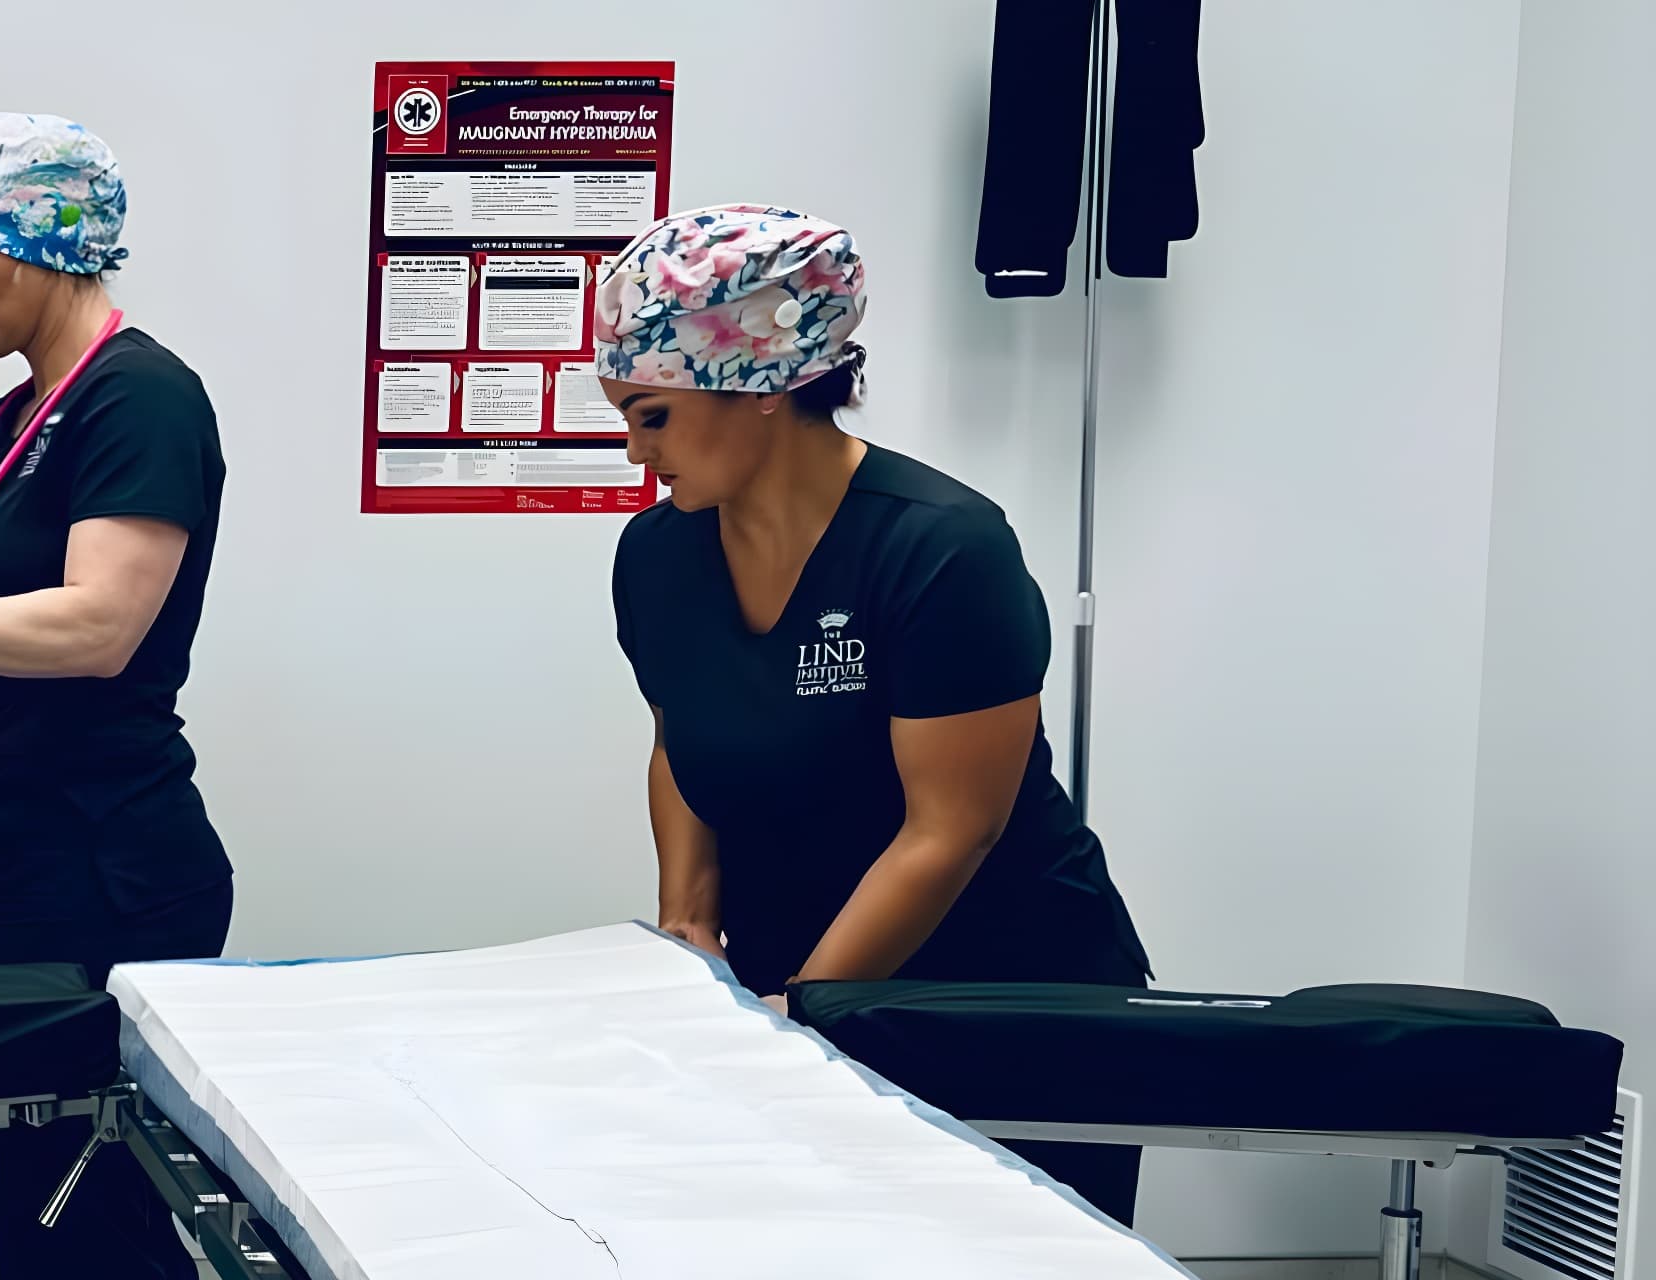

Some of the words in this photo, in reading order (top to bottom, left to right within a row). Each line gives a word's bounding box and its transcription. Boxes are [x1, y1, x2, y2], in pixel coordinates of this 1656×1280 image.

[509, 106, 580, 124] Emergency
[584, 105, 636, 124] Therapy
[639, 105, 659, 120] for
[459, 126, 547, 140] MALIGNANT
[549, 125, 657, 140] HYPERTHERMIA
[797, 639, 865, 668] LIND
